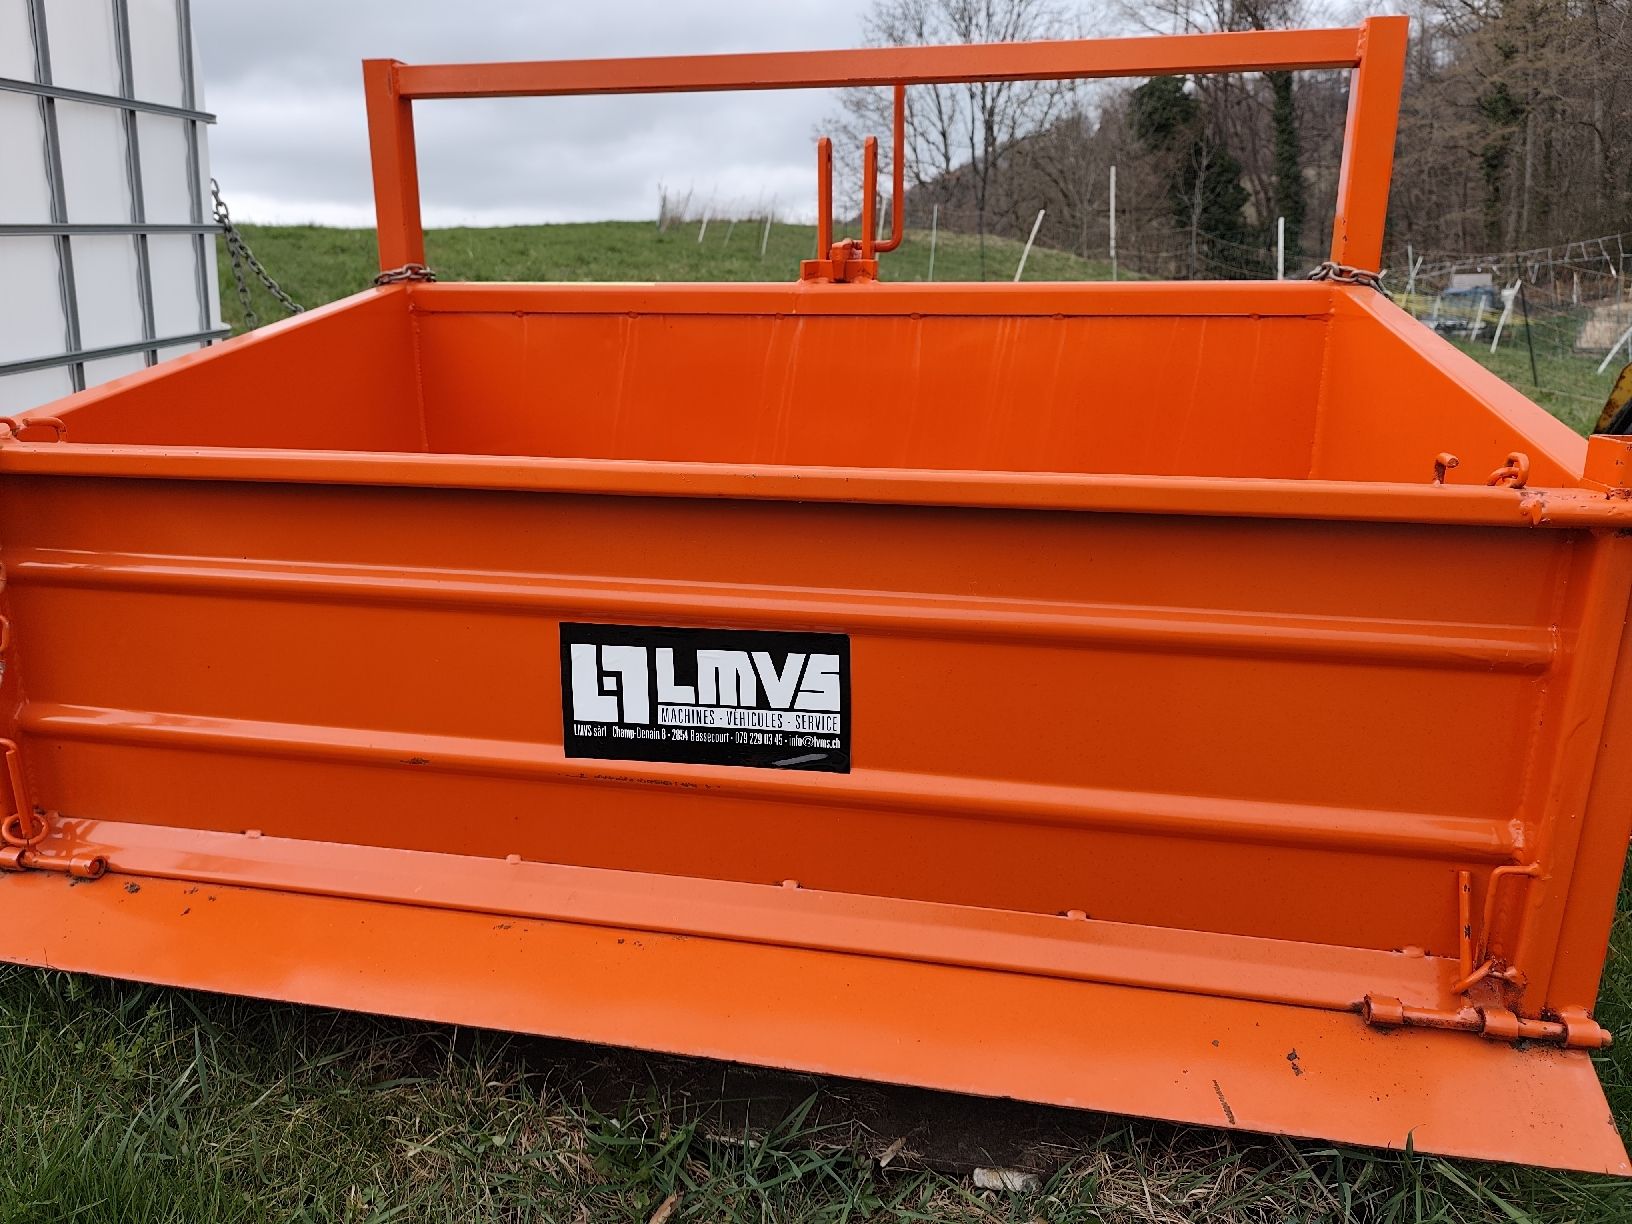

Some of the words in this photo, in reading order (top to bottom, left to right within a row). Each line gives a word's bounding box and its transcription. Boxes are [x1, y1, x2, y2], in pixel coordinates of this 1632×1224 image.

[656, 648, 841, 711] LMVS
[661, 707, 715, 724] MACHINES
[726, 710, 783, 728] VÉHICULES
[795, 714, 838, 732] SERVICE
[612, 725, 660, 741] Champ-Denain
[671, 728, 688, 741] 2854
[690, 729, 729, 743] Bassecourt
[735, 731, 748, 745] 079
[749, 732, 763, 745] 229
[763, 733, 773, 746] 03
[774, 733, 783, 746] 45
